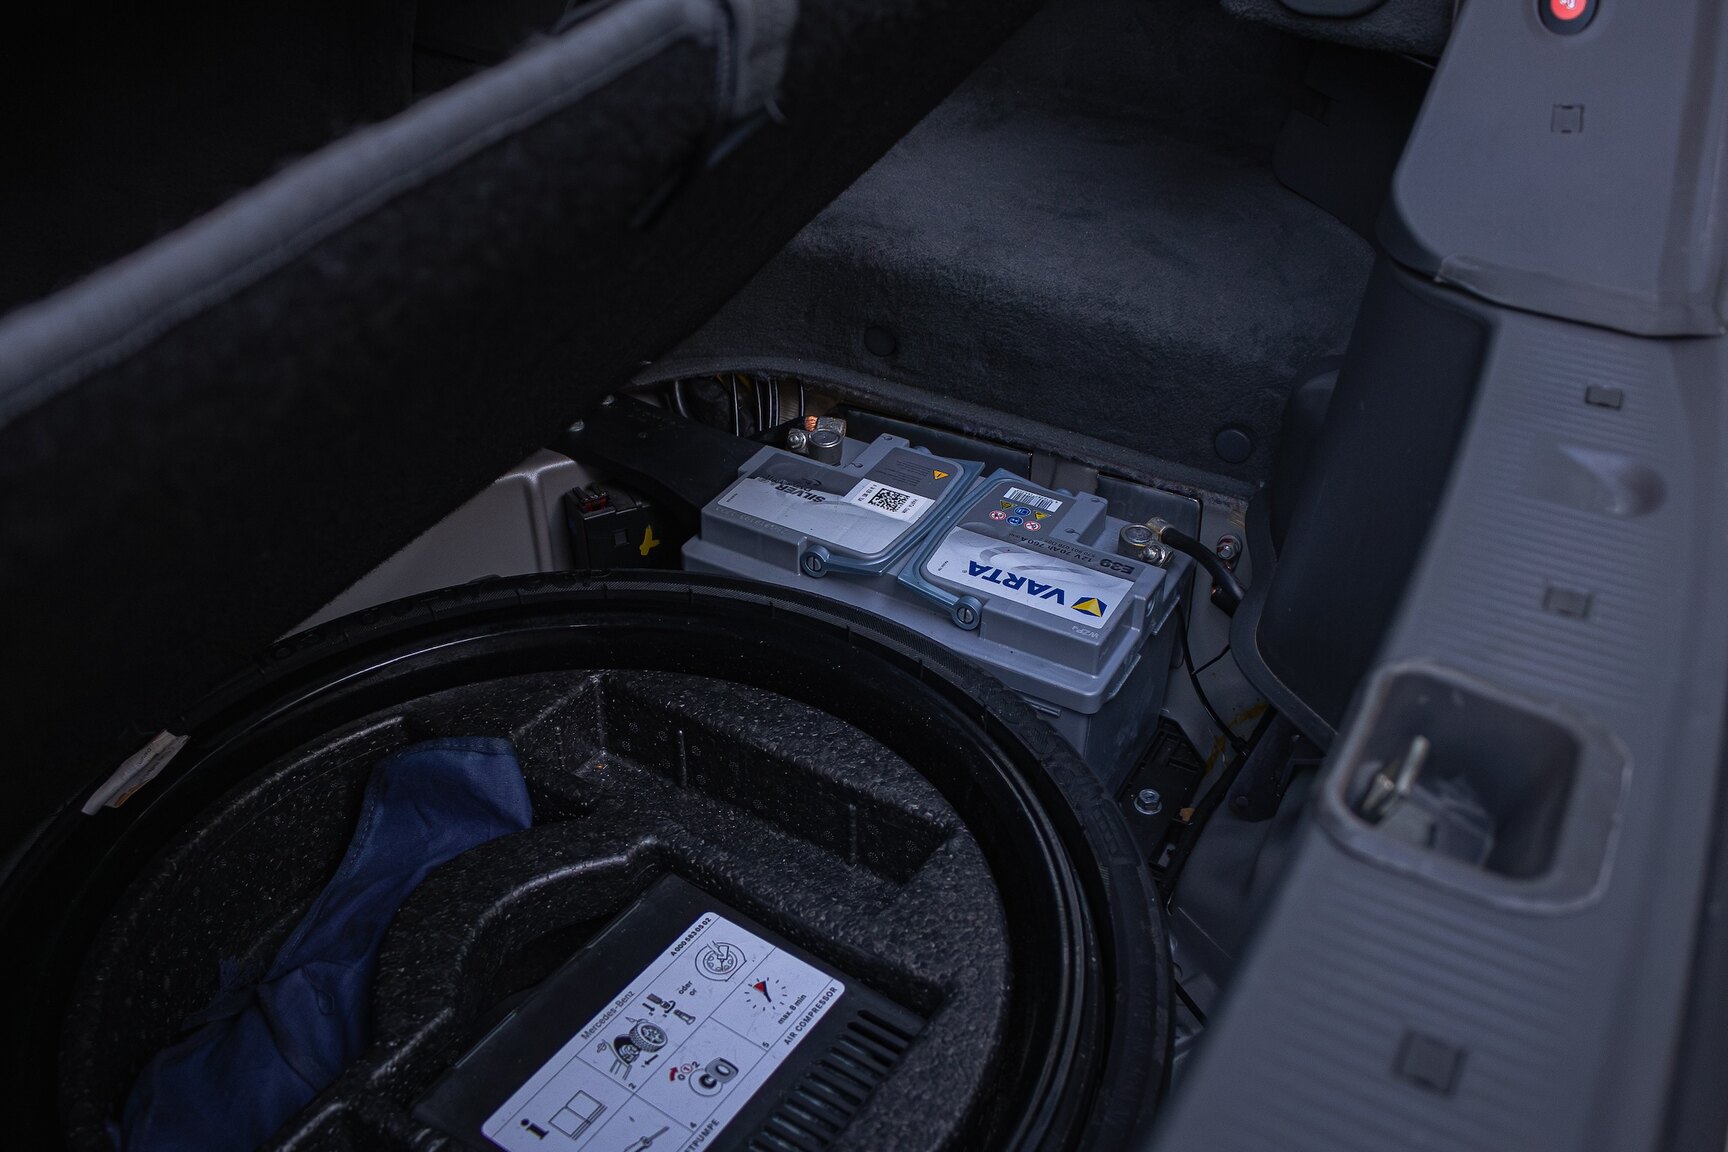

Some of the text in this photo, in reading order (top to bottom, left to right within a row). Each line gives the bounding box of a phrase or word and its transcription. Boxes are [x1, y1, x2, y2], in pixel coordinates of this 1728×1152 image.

[775, 485, 826, 502] SILVER
[1100, 558, 1135, 575] E39
[968, 560, 1065, 606] VARTA
[678, 980, 693, 995] oder
[689, 988, 697, 996] or
[581, 990, 635, 1040] Mercedes-Benz
[784, 986, 838, 1045] AIR COMPRESSOR
[762, 1041, 770, 1049] 5
[691, 1061, 700, 1069] 2
[628, 1082, 637, 1090] 2
